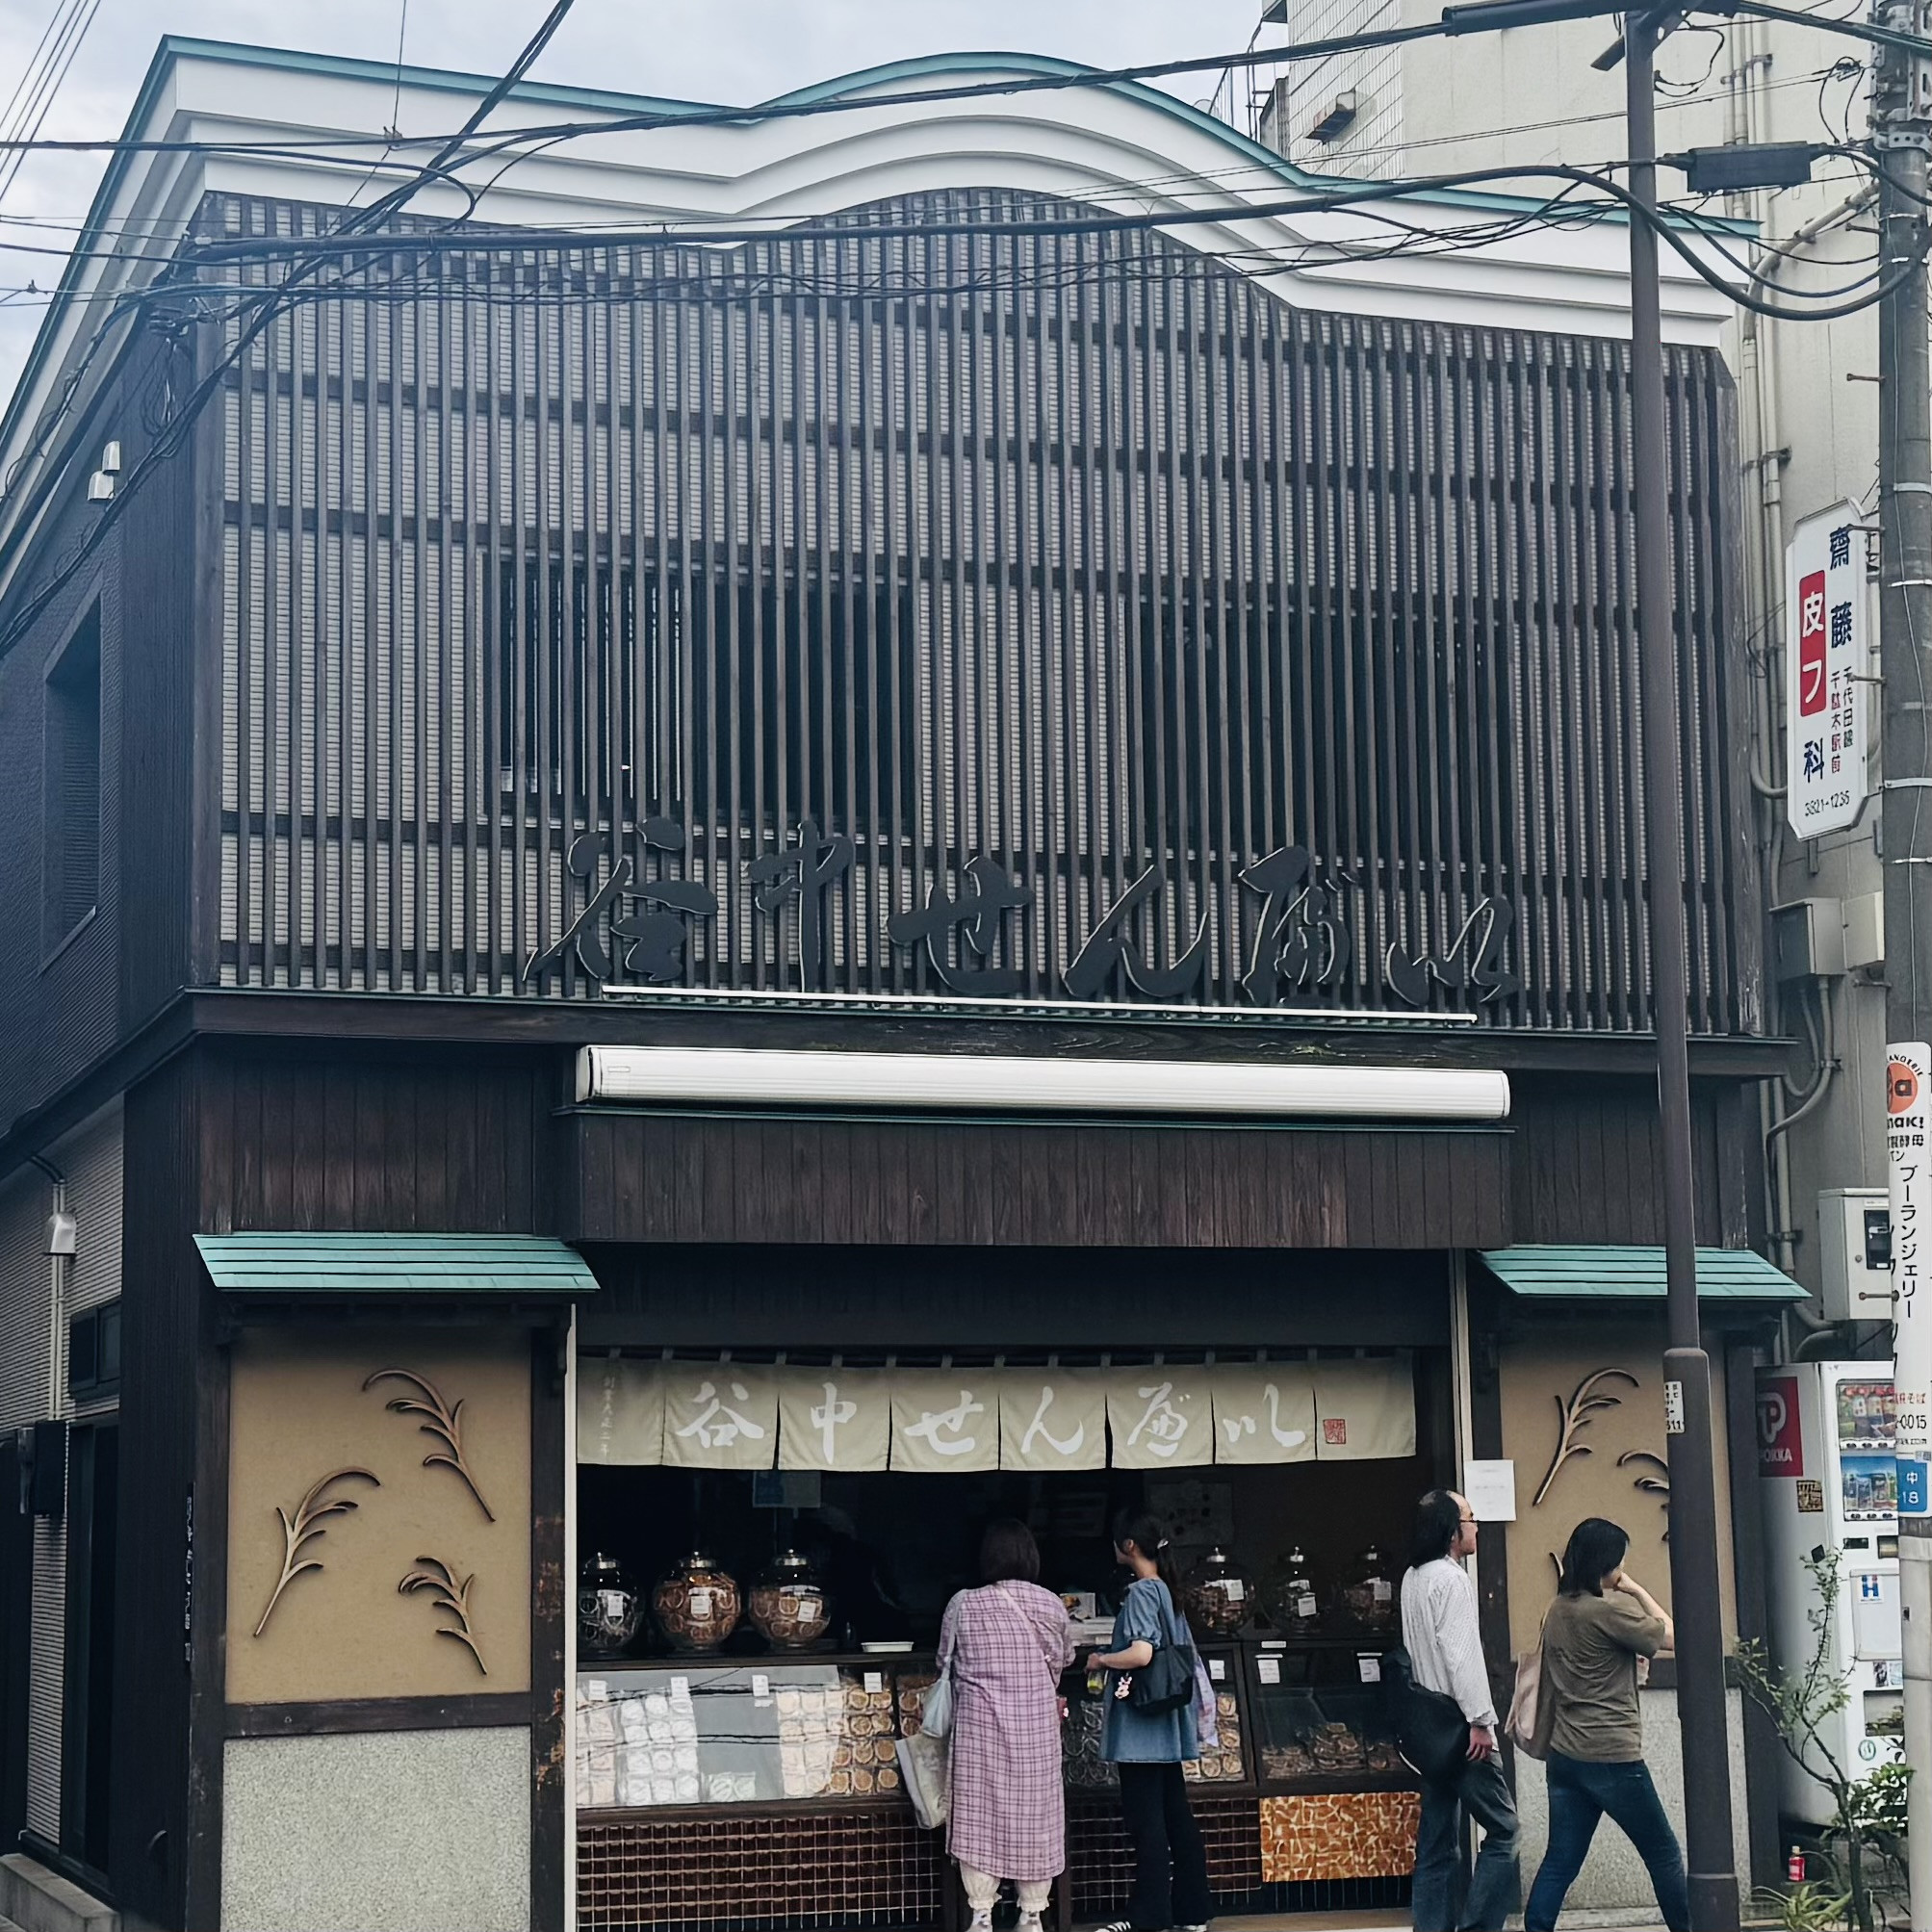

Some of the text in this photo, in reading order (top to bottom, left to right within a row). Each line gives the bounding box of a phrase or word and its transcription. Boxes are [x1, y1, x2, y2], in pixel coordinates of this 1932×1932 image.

[1801, 590, 1824, 784] 皮フ科
[1899, 1165, 1919, 1319] ブーランジェリー
